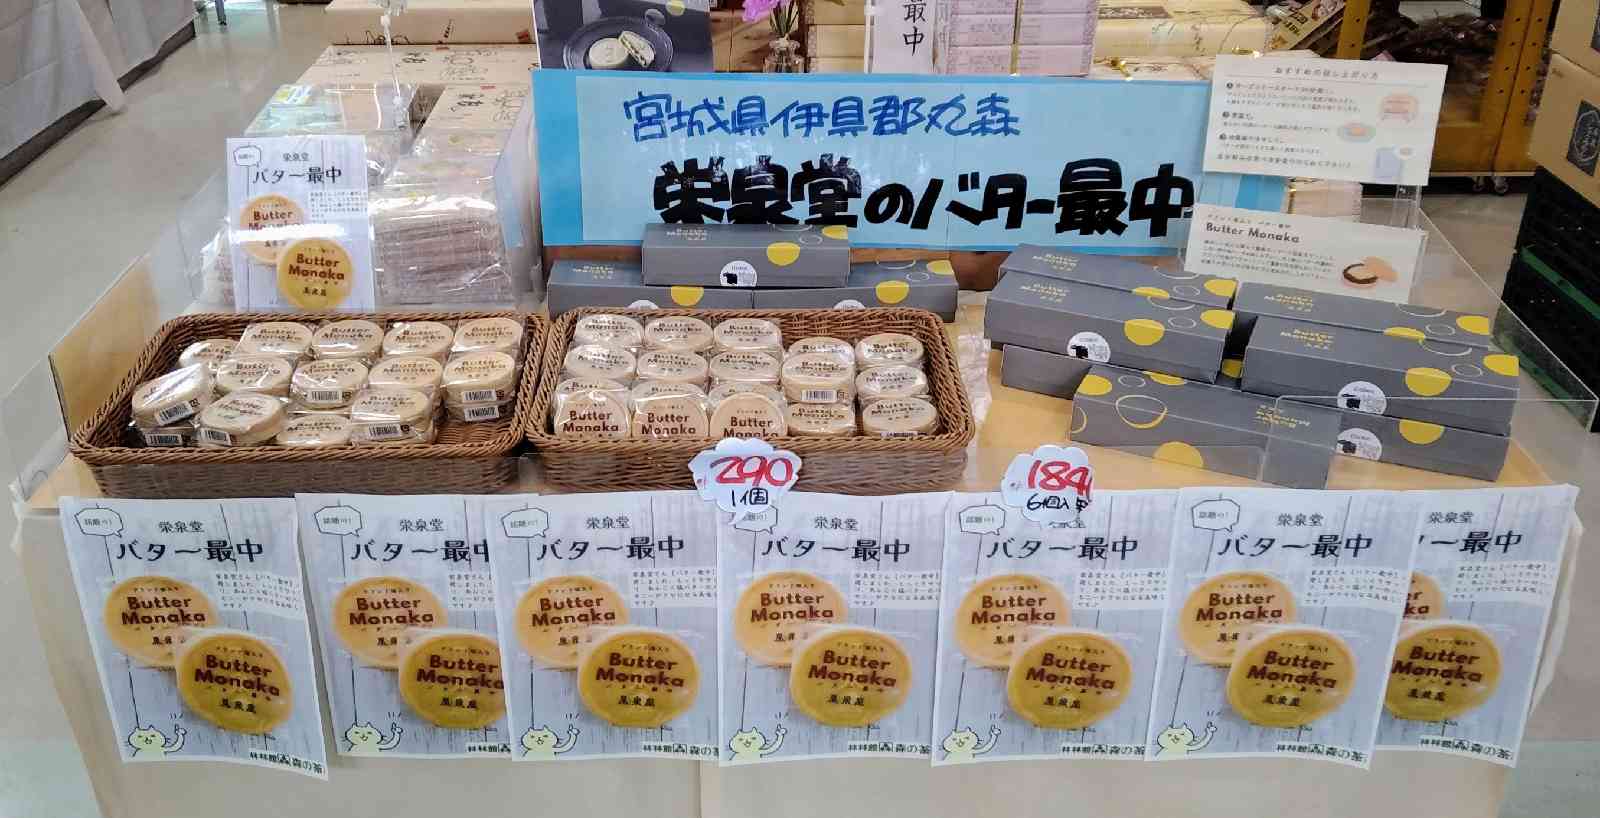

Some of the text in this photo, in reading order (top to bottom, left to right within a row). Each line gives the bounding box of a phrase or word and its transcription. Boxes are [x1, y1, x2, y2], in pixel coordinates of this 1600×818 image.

[654, 153, 1194, 237] 栄泉堂のバター最中
[253, 210, 293, 221] Butter
[1206, 222, 1300, 243] Butter Monaka
[296, 253, 340, 267] Butter
[288, 264, 345, 281] Monaka
[569, 410, 612, 421] Butter
[648, 413, 689, 423] Butter
[730, 416, 773, 427] Butter
[563, 421, 618, 432] Monaka
[642, 423, 696, 435] Monaka
[724, 428, 778, 438] Monaka
[710, 456, 793, 487] 290
[1028, 460, 1092, 502] 184
[731, 488, 768, 507] 1個
[400, 518, 444, 532] 栄泉堂
[586, 516, 631, 529] 栄泉堂
[814, 516, 859, 531] 栄泉堂
[1277, 512, 1324, 527] 栄泉堂
[1428, 512, 1473, 524] 栄泉堂
[158, 521, 205, 534] 栄泉堂
[117, 538, 264, 562] バター最中
[536, 535, 685, 560] バター最中
[762, 536, 910, 562] バター最中
[986, 535, 1138, 560] バター最中
[1218, 533, 1373, 558] バター最中
[127, 596, 192, 610] Butter
[357, 597, 421, 611] Butter
[539, 596, 605, 612] Butter
[760, 593, 824, 608] Butter
[981, 595, 1047, 610] Butter
[1208, 592, 1276, 607] Butter
[121, 609, 206, 625] Monaka
[349, 611, 434, 626] Monaka
[531, 609, 616, 627] Monaka
[750, 606, 834, 623] Monaka
[971, 608, 1056, 626] Monaka
[1196, 606, 1282, 622] Monaka
[429, 655, 498, 674] Butter
[608, 652, 679, 671] Butter
[823, 649, 891, 671] Butter
[1041, 652, 1112, 673] Butter
[1263, 650, 1334, 672] Butter
[1410, 646, 1480, 665] Butter
[205, 654, 273, 677] Butter
[1392, 661, 1482, 683] Monaka
[194, 668, 281, 698] Monaka
[416, 669, 504, 690] Monaka
[595, 668, 685, 687] Monaka
[807, 664, 897, 688] Monaka
[1025, 667, 1116, 691] Monaka
[1247, 665, 1337, 689] Monaka
